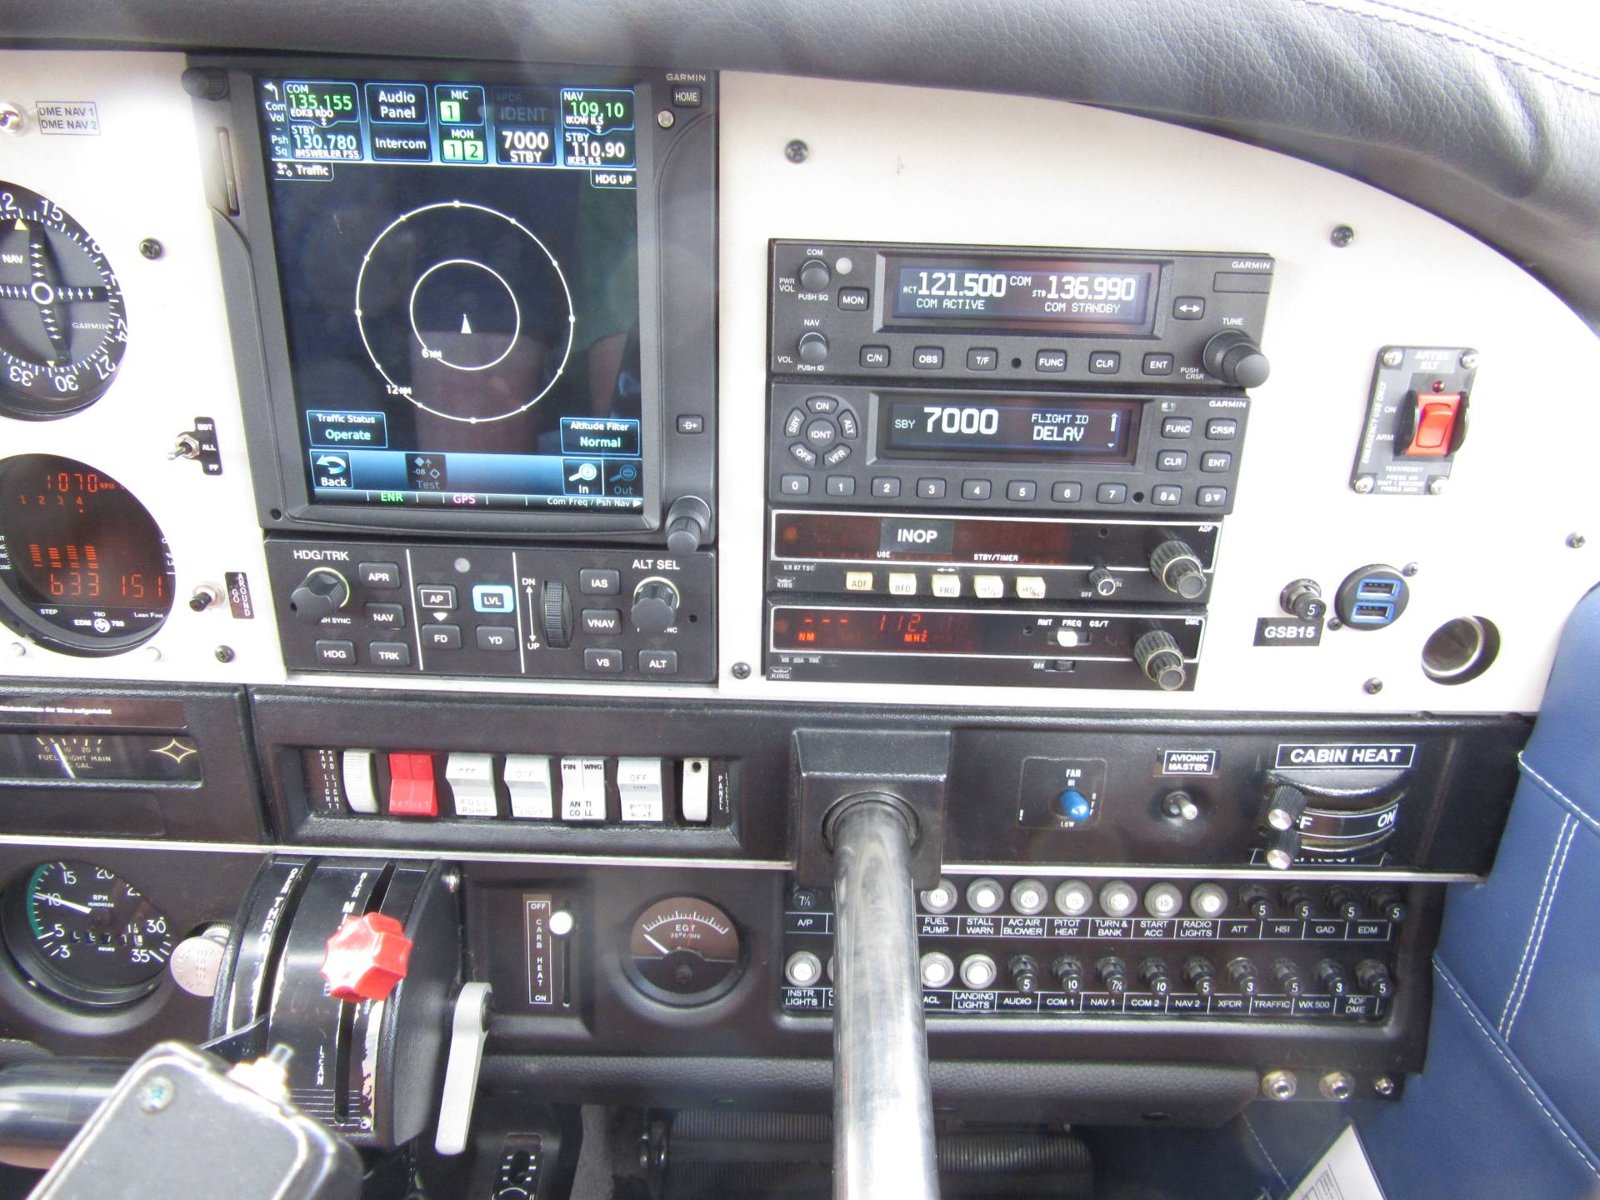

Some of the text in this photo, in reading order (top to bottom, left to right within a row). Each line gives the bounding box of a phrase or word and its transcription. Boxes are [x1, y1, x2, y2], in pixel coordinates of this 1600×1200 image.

[665, 73, 706, 82] GARMIN
[286, 84, 309, 93] COM
[378, 91, 416, 103] Audio
[451, 90, 469, 100] MIC
[563, 92, 584, 101] NAV
[675, 92, 698, 102] HOME
[265, 101, 287, 111] Com
[290, 95, 353, 110] 135.155
[380, 106, 416, 119] Panel
[500, 106, 548, 121] IDENT
[571, 102, 625, 117] 109.10
[269, 113, 285, 122] Vol
[41, 119, 64, 129] DME
[67, 119, 88, 129] NAV
[291, 125, 315, 135] STBY
[451, 129, 474, 139] MON
[271, 135, 288, 145] Psh
[502, 131, 549, 150] 7000
[565, 133, 589, 142] STBY
[293, 135, 357, 150] 130.780
[375, 138, 427, 150] Intercom
[275, 146, 288, 158] Sq
[572, 142, 625, 158] 110.90
[509, 151, 543, 163] STBY
[295, 164, 329, 176] Traffic
[595, 174, 632, 185] HDG UP
[2, 254, 23, 264] NAV
[1231, 261, 1271, 270] GARMIN
[918, 271, 1007, 298] 121.500
[1009, 276, 1032, 287] COM
[1046, 275, 1136, 301] 136.990
[842, 296, 865, 305] MON
[916, 298, 986, 310] COM ACTIVE
[1045, 302, 1121, 314] COM STANDBY
[72, 322, 109, 330] GARMIN
[1222, 318, 1243, 326] TUNE
[867, 354, 883, 363] C/N
[918, 355, 938, 364] OBS
[1039, 358, 1064, 367] FUNC
[95, 355, 116, 380] 27
[1096, 359, 1113, 368] CLR
[1150, 360, 1168, 369] ENT
[9, 365, 34, 387] 33
[54, 373, 79, 392] 30
[815, 402, 830, 410] ON
[1209, 400, 1247, 409] GARMIN
[316, 414, 376, 425] Traffic Status
[923, 406, 999, 435] 7000
[1031, 413, 1089, 425] FLIGHT ID
[569, 421, 629, 432] Altitude Filter
[789, 416, 801, 433] SBY
[843, 419, 854, 435] ALT
[894, 419, 916, 429] SBY
[1166, 425, 1190, 434] FUNC
[1210, 426, 1235, 434] CRSR
[324, 430, 372, 443] Operate
[811, 430, 832, 439] IDNT
[579, 436, 622, 449] Normal
[796, 448, 812, 462] OFF
[829, 449, 847, 464] VFR
[1163, 457, 1182, 466] CLR
[1208, 458, 1226, 467] ENT
[320, 476, 347, 488] Back
[415, 479, 440, 491] Test
[578, 484, 589, 495] In
[612, 484, 633, 496] Out
[380, 493, 404, 503] ENR
[453, 494, 476, 505] GPS
[897, 528, 938, 543] INOP
[293, 550, 350, 561] HDG/TRK
[632, 560, 680, 571] ALT SEL
[368, 573, 390, 582] APR
[522, 578, 536, 586] DN
[591, 580, 608, 588] IAS
[851, 580, 868, 588] ADF
[429, 595, 444, 603] AP
[484, 597, 501, 605] LVL
[1307, 604, 1316, 616] 5
[373, 613, 394, 622] NAV
[587, 619, 615, 628] VNAV
[798, 632, 815, 641] NM
[1264, 626, 1315, 639] GSB15
[433, 635, 448, 643] FD
[488, 636, 503, 645] YD
[527, 642, 539, 650] UP
[323, 650, 346, 659] HDG
[379, 651, 400, 660] TRK
[596, 659, 610, 667] VS
[649, 660, 667, 668] ALT
[1170, 754, 1209, 763] AVIONIC
[1290, 748, 1401, 763] CABIN HEAT
[1168, 763, 1208, 771] MASTER
[1066, 769, 1081, 778] FAN
[1377, 810, 1397, 828] ON
[63, 871, 77, 885] 15
[146, 919, 166, 933] 30
[1054, 919, 1080, 927] PITOT
[1140, 920, 1168, 928] START
[1183, 921, 1211, 929] RADIO
[54, 924, 65, 937] 5
[922, 926, 949, 934] PUMP
[966, 926, 994, 934] WARN
[1003, 927, 1043, 936] BLOWER
[1055, 928, 1078, 936] HEAT
[1098, 929, 1122, 937] BANK
[1144, 929, 1163, 937] ACC
[1180, 929, 1212, 937] LIGHTS
[60, 945, 70, 958] 3
[131, 949, 150, 963] 35
[923, 996, 940, 1004] ACL
[954, 992, 994, 1000] LANDING
[785, 997, 818, 1006] LIGHTS
[957, 1001, 990, 1009] LIGHTS
[1003, 997, 1032, 1006] AUDIO
[1218, 1000, 1242, 1008] XPDR
[1254, 1000, 1291, 1009] TRAFFIC
[1315, 1001, 1330, 1009] 500
[1345, 1006, 1365, 1014] DME
